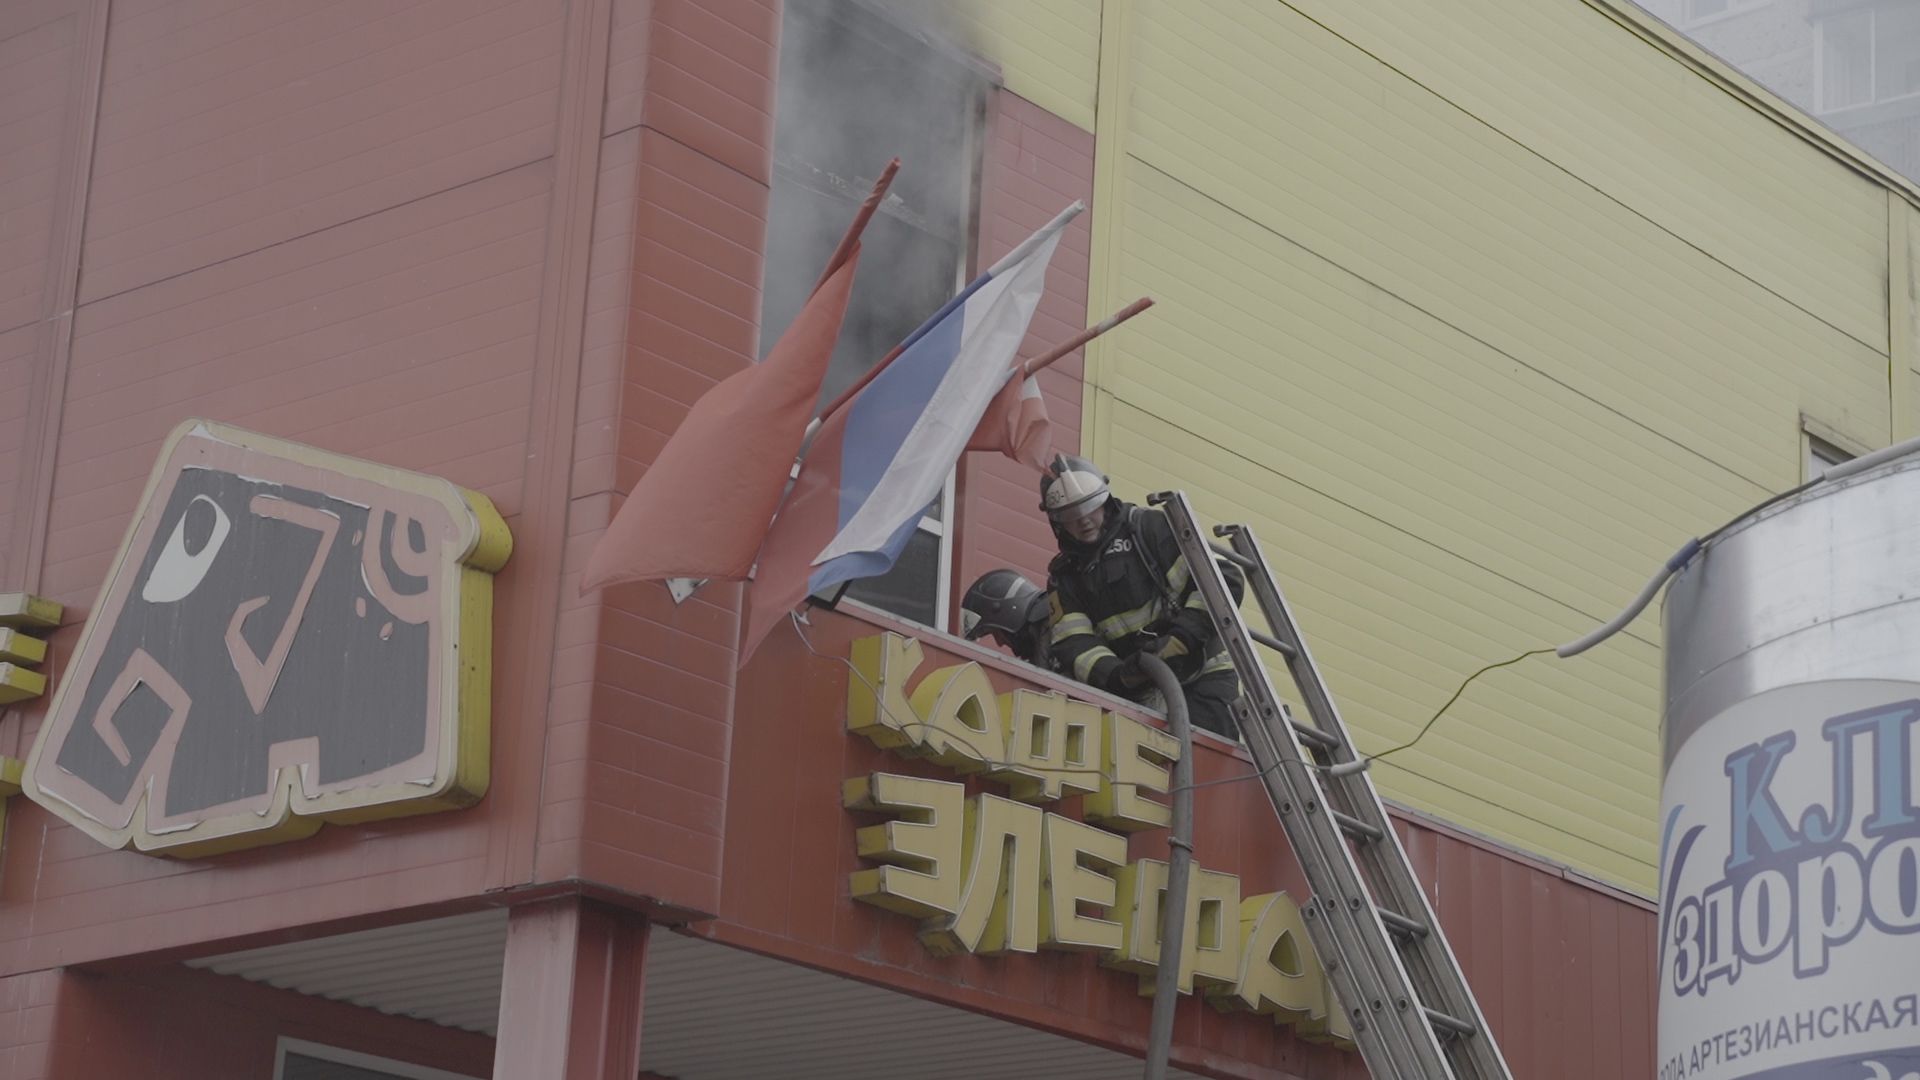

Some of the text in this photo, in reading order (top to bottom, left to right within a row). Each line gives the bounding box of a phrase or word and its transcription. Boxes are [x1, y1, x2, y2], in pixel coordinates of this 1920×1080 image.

[849, 631, 1182, 829] КАФЕ
[844, 771, 1357, 1042] ЭЛЕФА
[1688, 993, 1917, 1077] АРТЕЗИАНСКАЯ
